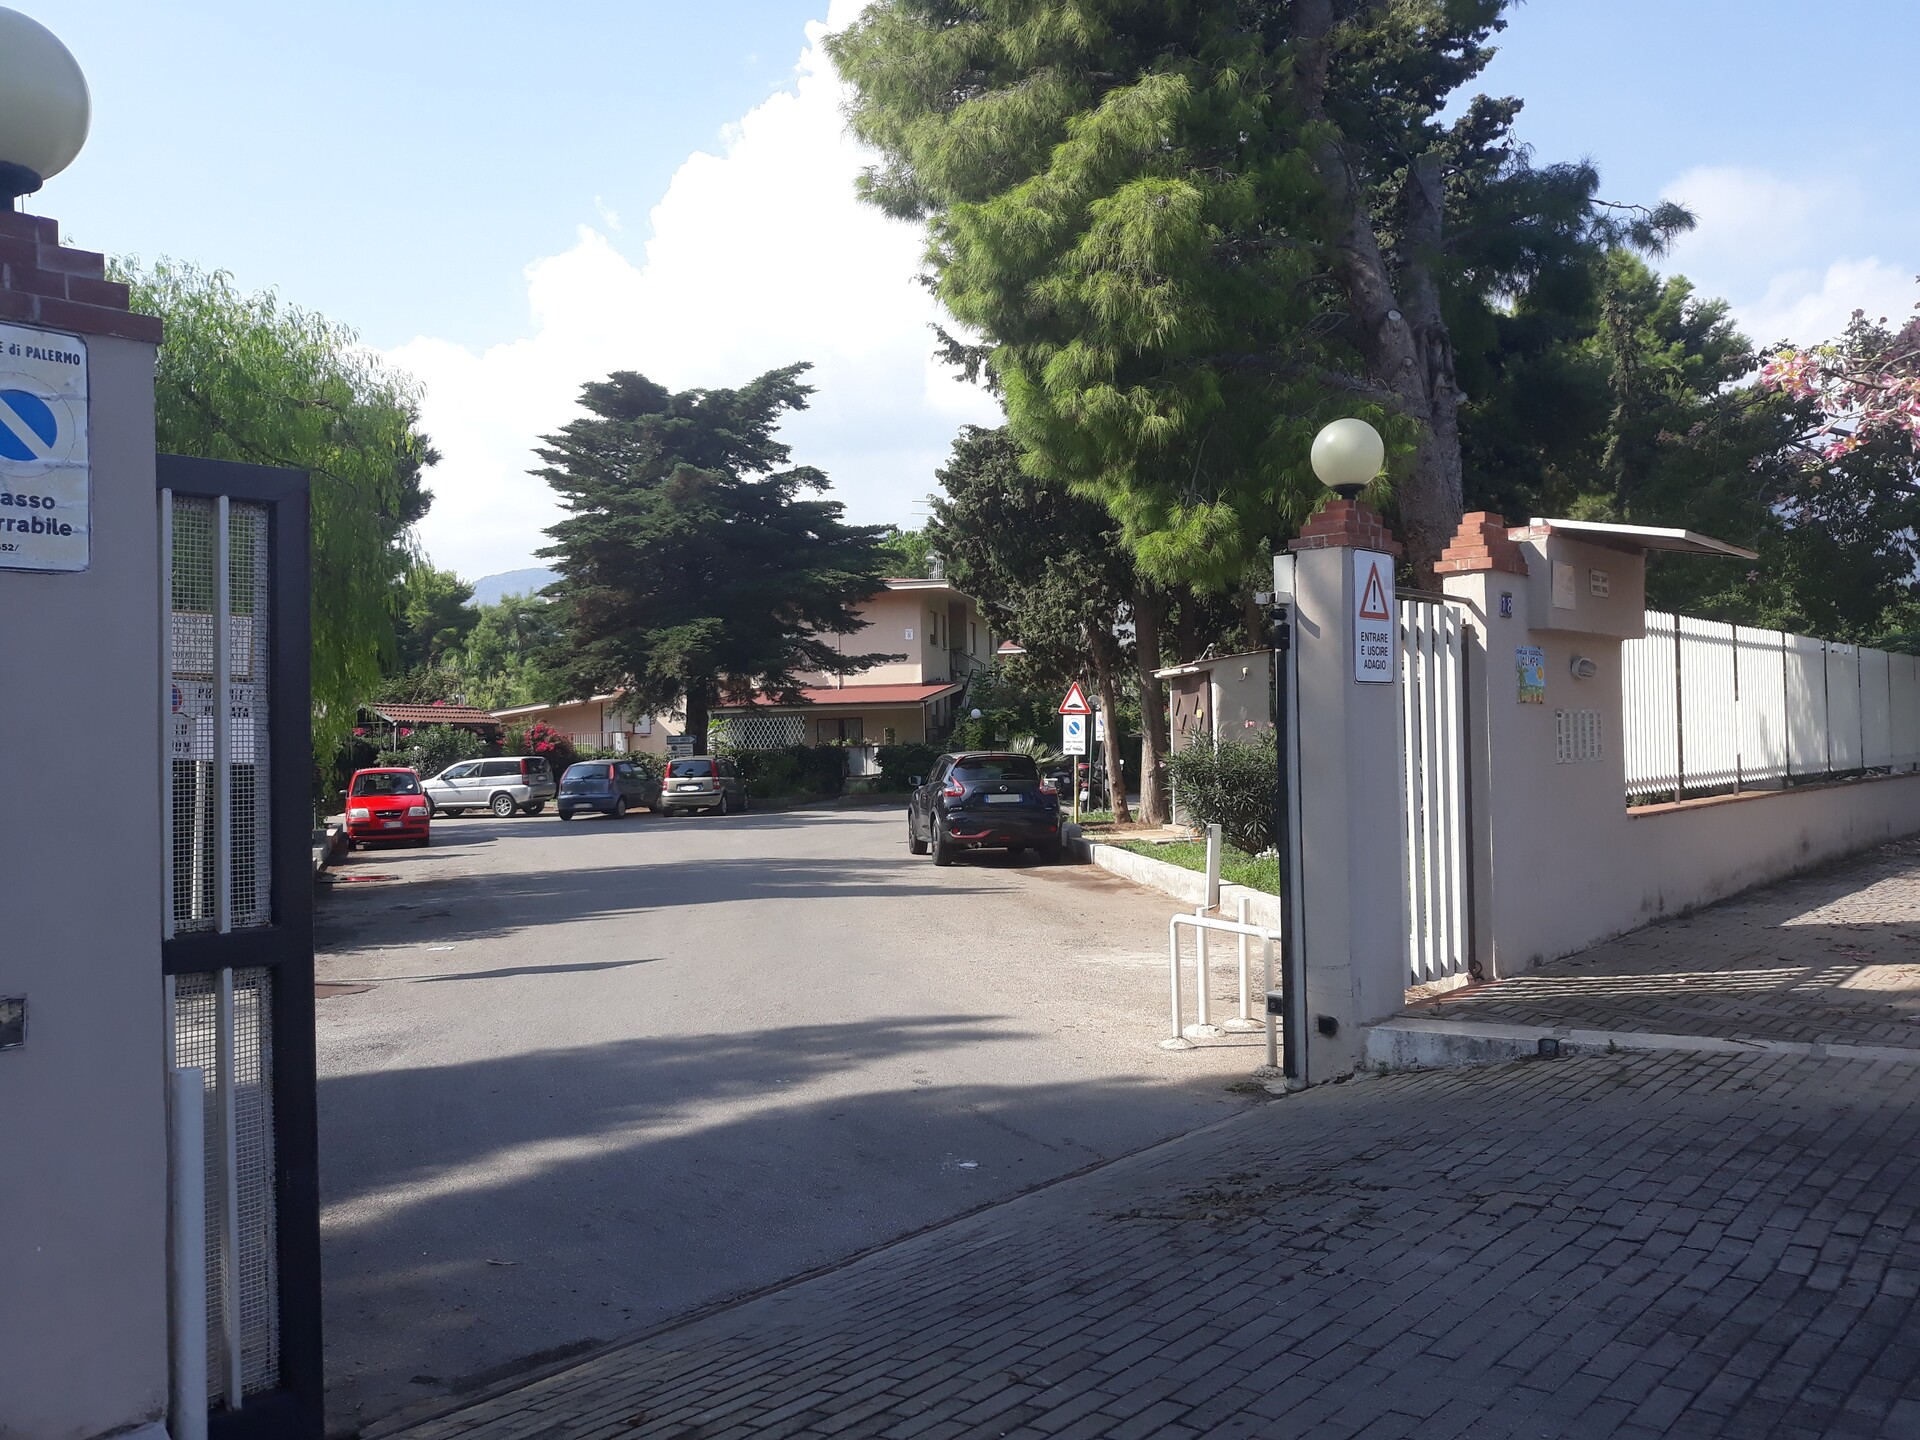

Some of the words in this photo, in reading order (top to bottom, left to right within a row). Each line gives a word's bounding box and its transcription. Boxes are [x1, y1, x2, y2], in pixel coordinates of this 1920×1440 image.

[9, 344, 20, 356] di
[26, 346, 80, 365] PALERMO
[0, 493, 55, 510] asso
[0, 543, 19, 551] 52/
[1361, 632, 1388, 643] ENTRARE
[1361, 645, 1365, 655] E
[1367, 646, 1388, 656] USCIRE
[1364, 659, 1386, 670] ADAGIO
